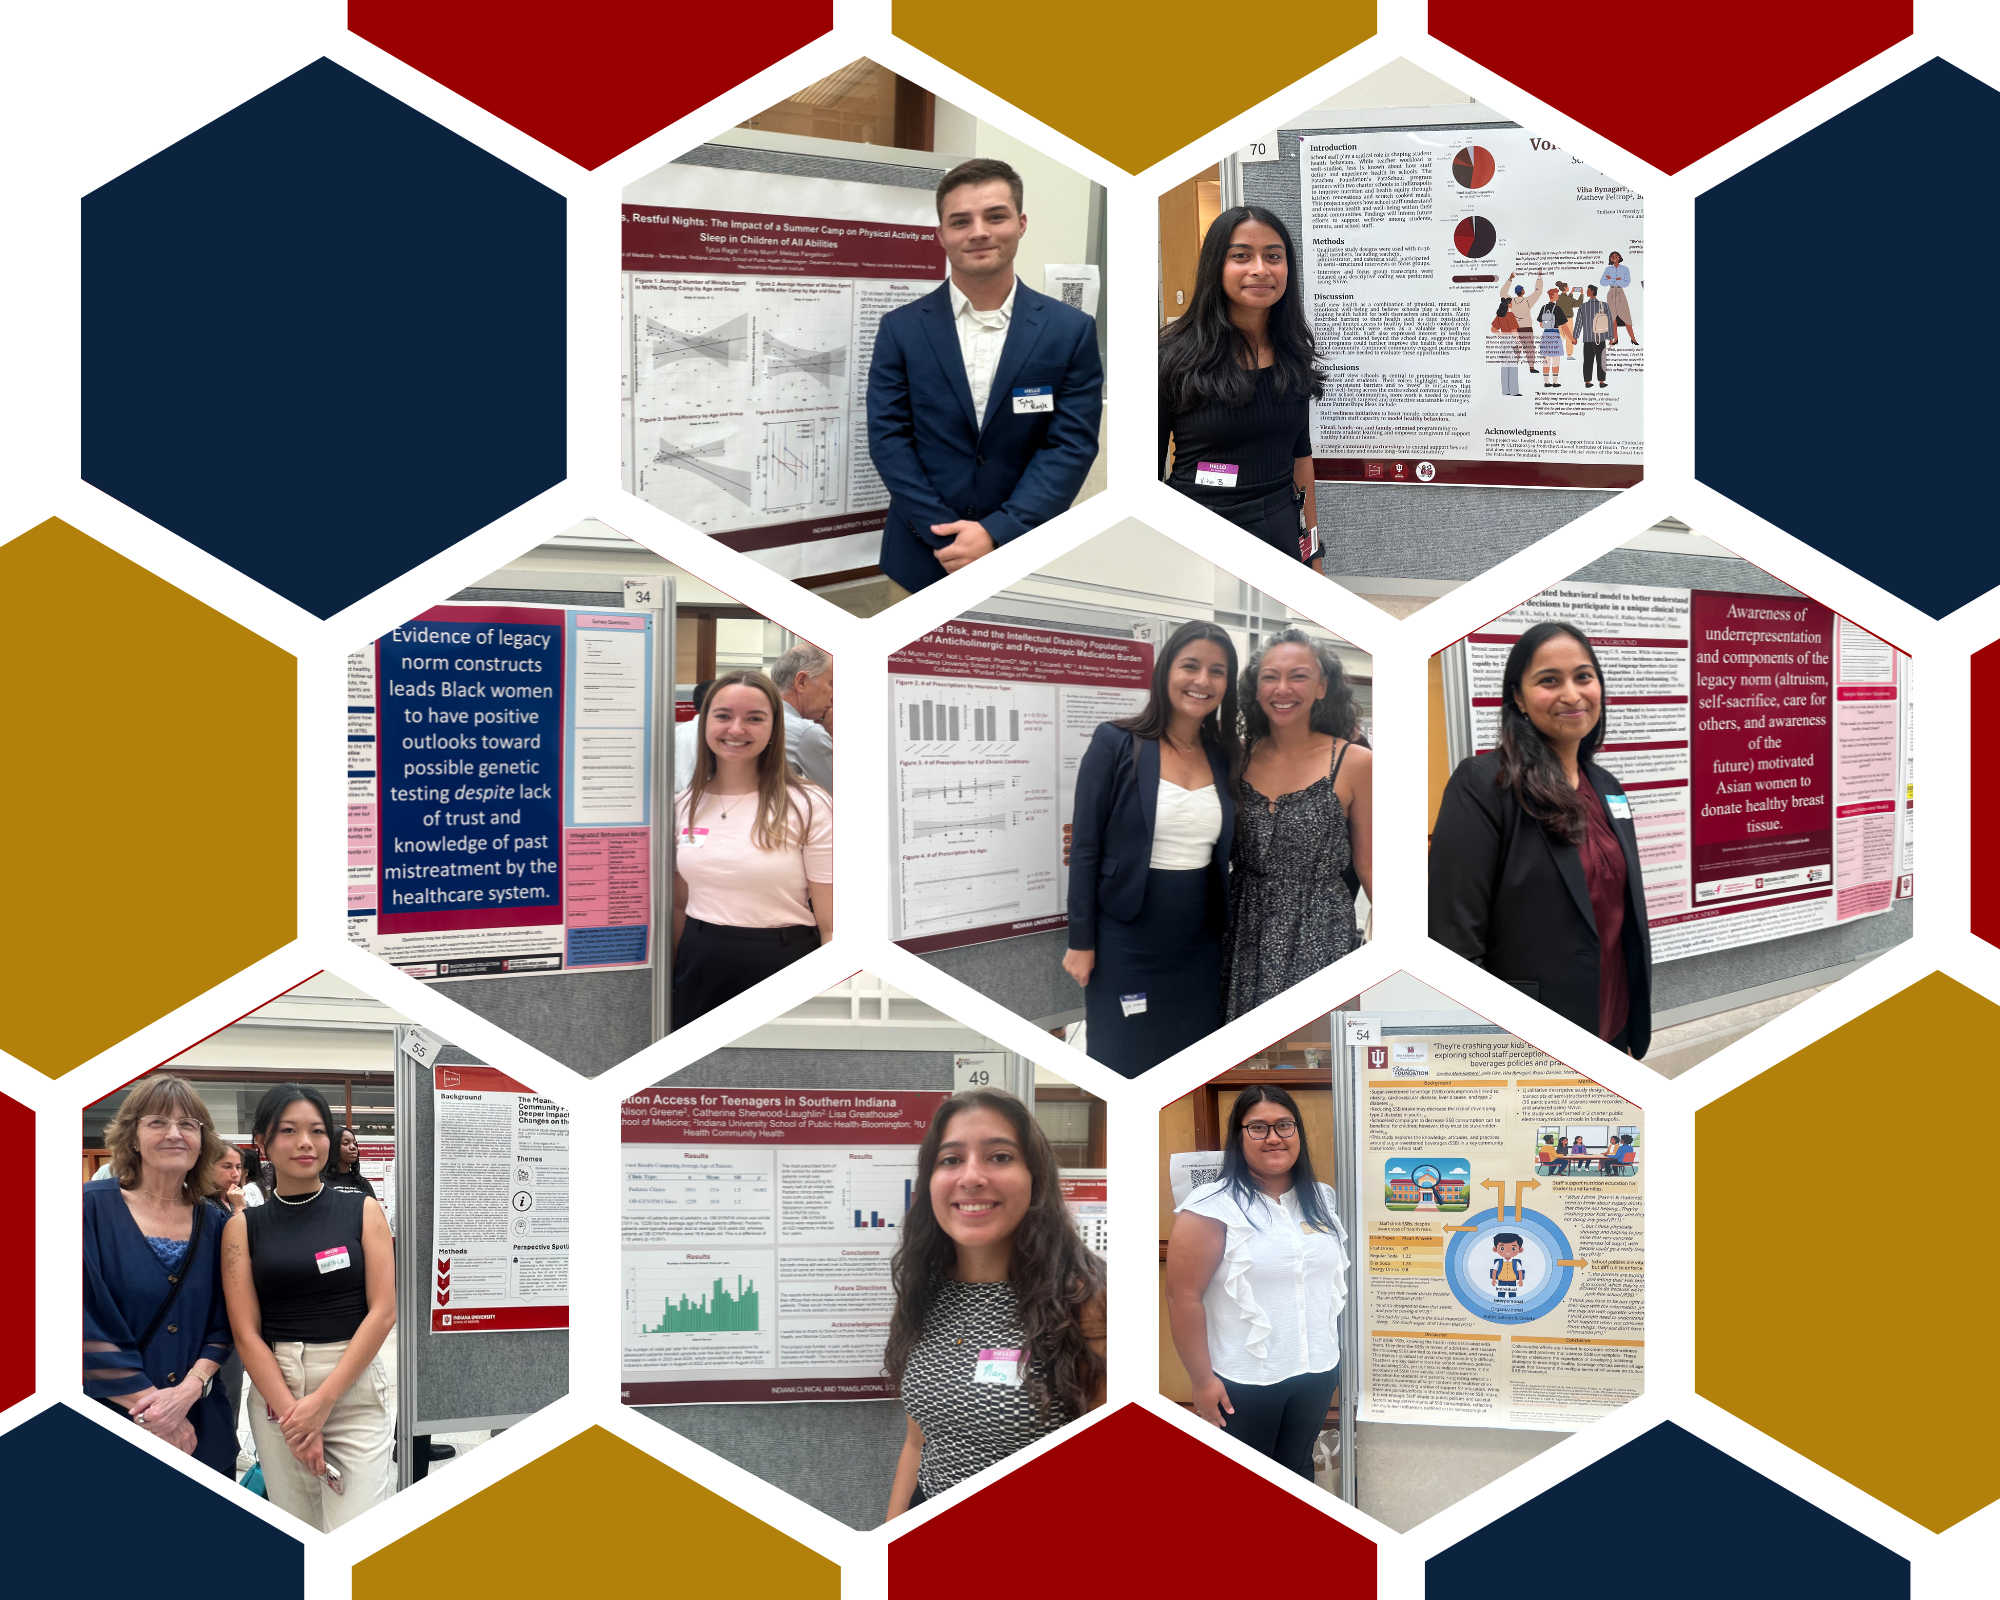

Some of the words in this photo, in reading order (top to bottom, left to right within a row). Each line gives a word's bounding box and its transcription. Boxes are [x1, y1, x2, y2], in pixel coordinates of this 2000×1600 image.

[1249, 143, 1266, 156] 70
[1310, 144, 1357, 152] Introduction
[633, 213, 669, 224] Restful
[672, 215, 708, 227] Nights:
[711, 218, 728, 227] The
[731, 219, 762, 231] Impact
[764, 223, 774, 231] of
[783, 223, 819, 233] Summer
[821, 225, 845, 236] Camp
[859, 228, 891, 239] Physical
[892, 230, 920, 241] Activity
[921, 233, 935, 241] and
[700, 232, 727, 244] Sleep
[729, 235, 738, 243] in
[740, 235, 779, 246] Children
[781, 238, 790, 246] of
[791, 238, 803, 247] All
[805, 239, 838, 249] Abilities
[1484, 428, 1557, 437] Acknowledgments
[635, 591, 651, 603] 34
[1727, 604, 1791, 621] Awareness
[1794, 608, 1808, 621] of
[392, 626, 471, 644] Evidence
[476, 629, 495, 644] of
[499, 629, 551, 650] legacy
[947, 625, 970, 637] Risk,
[972, 629, 989, 638] and
[991, 631, 1005, 639] the
[1007, 632, 1051, 644] Intellectual
[1053, 636, 1087, 649] Disability
[1089, 640, 1129, 652] Population:
[1141, 629, 1152, 639] 57
[1706, 626, 1822, 645] underrepresentation
[923, 635, 933, 643] of
[935, 635, 1004, 651] Anticholinergic
[1006, 642, 1022, 651] and
[1024, 644, 1075, 659] Psychotropic
[1076, 648, 1116, 660] Medication
[1117, 653, 1142, 663] Burden
[402, 657, 449, 670] norm
[455, 658, 543, 672] constructs
[1696, 649, 1719, 664] and
[1723, 652, 1794, 667] components
[1797, 651, 1811, 664] of
[1812, 651, 1829, 664] the
[389, 680, 436, 696] leads
[441, 681, 486, 697] Black
[490, 686, 553, 698] women
[1697, 672, 1737, 690] legacy
[1740, 676, 1772, 686] norm
[1774, 672, 1829, 689] (altruism,
[1698, 693, 1780, 709] self-sacrifice,
[1783, 695, 1807, 706] care
[1810, 692, 1827, 706] for
[404, 709, 423, 723] to
[428, 707, 469, 723] have
[474, 709, 539, 727] positive
[1698, 715, 1741, 732] others,
[1744, 715, 1766, 729] and
[1768, 715, 1827, 728] awareness
[402, 734, 477, 749] outlooks
[482, 734, 541, 749] toward
[1748, 736, 1763, 750] of
[1764, 736, 1782, 749] the
[404, 759, 474, 779] possible
[478, 760, 540, 778] genetic
[1713, 758, 1755, 774] future)
[1757, 753, 1815, 771] motivated
[390, 785, 450, 804] testing
[454, 785, 515, 803] despite
[519, 783, 552, 799] lack
[1716, 780, 1752, 794] Asian
[1755, 778, 1798, 790] women
[1800, 776, 1812, 787] to
[1701, 799, 1743, 818] donate
[1745, 797, 1788, 812] healthy
[1791, 793, 1825, 808] breast
[423, 810, 441, 826] of
[445, 811, 486, 826] trust
[490, 809, 521, 824] and
[1747, 819, 1783, 833] tissue.
[395, 835, 488, 854] knowledge
[492, 834, 511, 850] of
[514, 835, 549, 853] past
[385, 862, 502, 879] mistreatment
[506, 859, 526, 877] by
[530, 858, 557, 874] the
[393, 887, 484, 905] healthcare
[488, 886, 550, 904] system.
[1356, 1030, 1370, 1041] 54
[411, 1043, 427, 1058] 55
[1434, 1051, 1467, 1060] exploring
[1491, 1050, 1509, 1058] staff
[1462, 1042, 1492, 1051] crashing
[1492, 1043, 1509, 1051] your
[1470, 1060, 1506, 1068] beverages
[1507, 1060, 1533, 1068] policies
[969, 1070, 990, 1086] 49
[440, 1093, 482, 1101] Background
[653, 1094, 697, 1106] Access
[700, 1094, 718, 1106] for
[720, 1095, 782, 1109] Teenagers
[785, 1096, 796, 1107] in
[799, 1096, 852, 1107] Southern
[854, 1097, 897, 1108] Indiana
[518, 1103, 560, 1112] Community
[518, 1110, 544, 1119] Deeper
[692, 1108, 736, 1118] Catherine
[828, 1110, 847, 1119] Lisa
[518, 1117, 550, 1126] Changes
[513, 1243, 551, 1251] Perspective
[983, 1363, 1007, 1381] Mary
